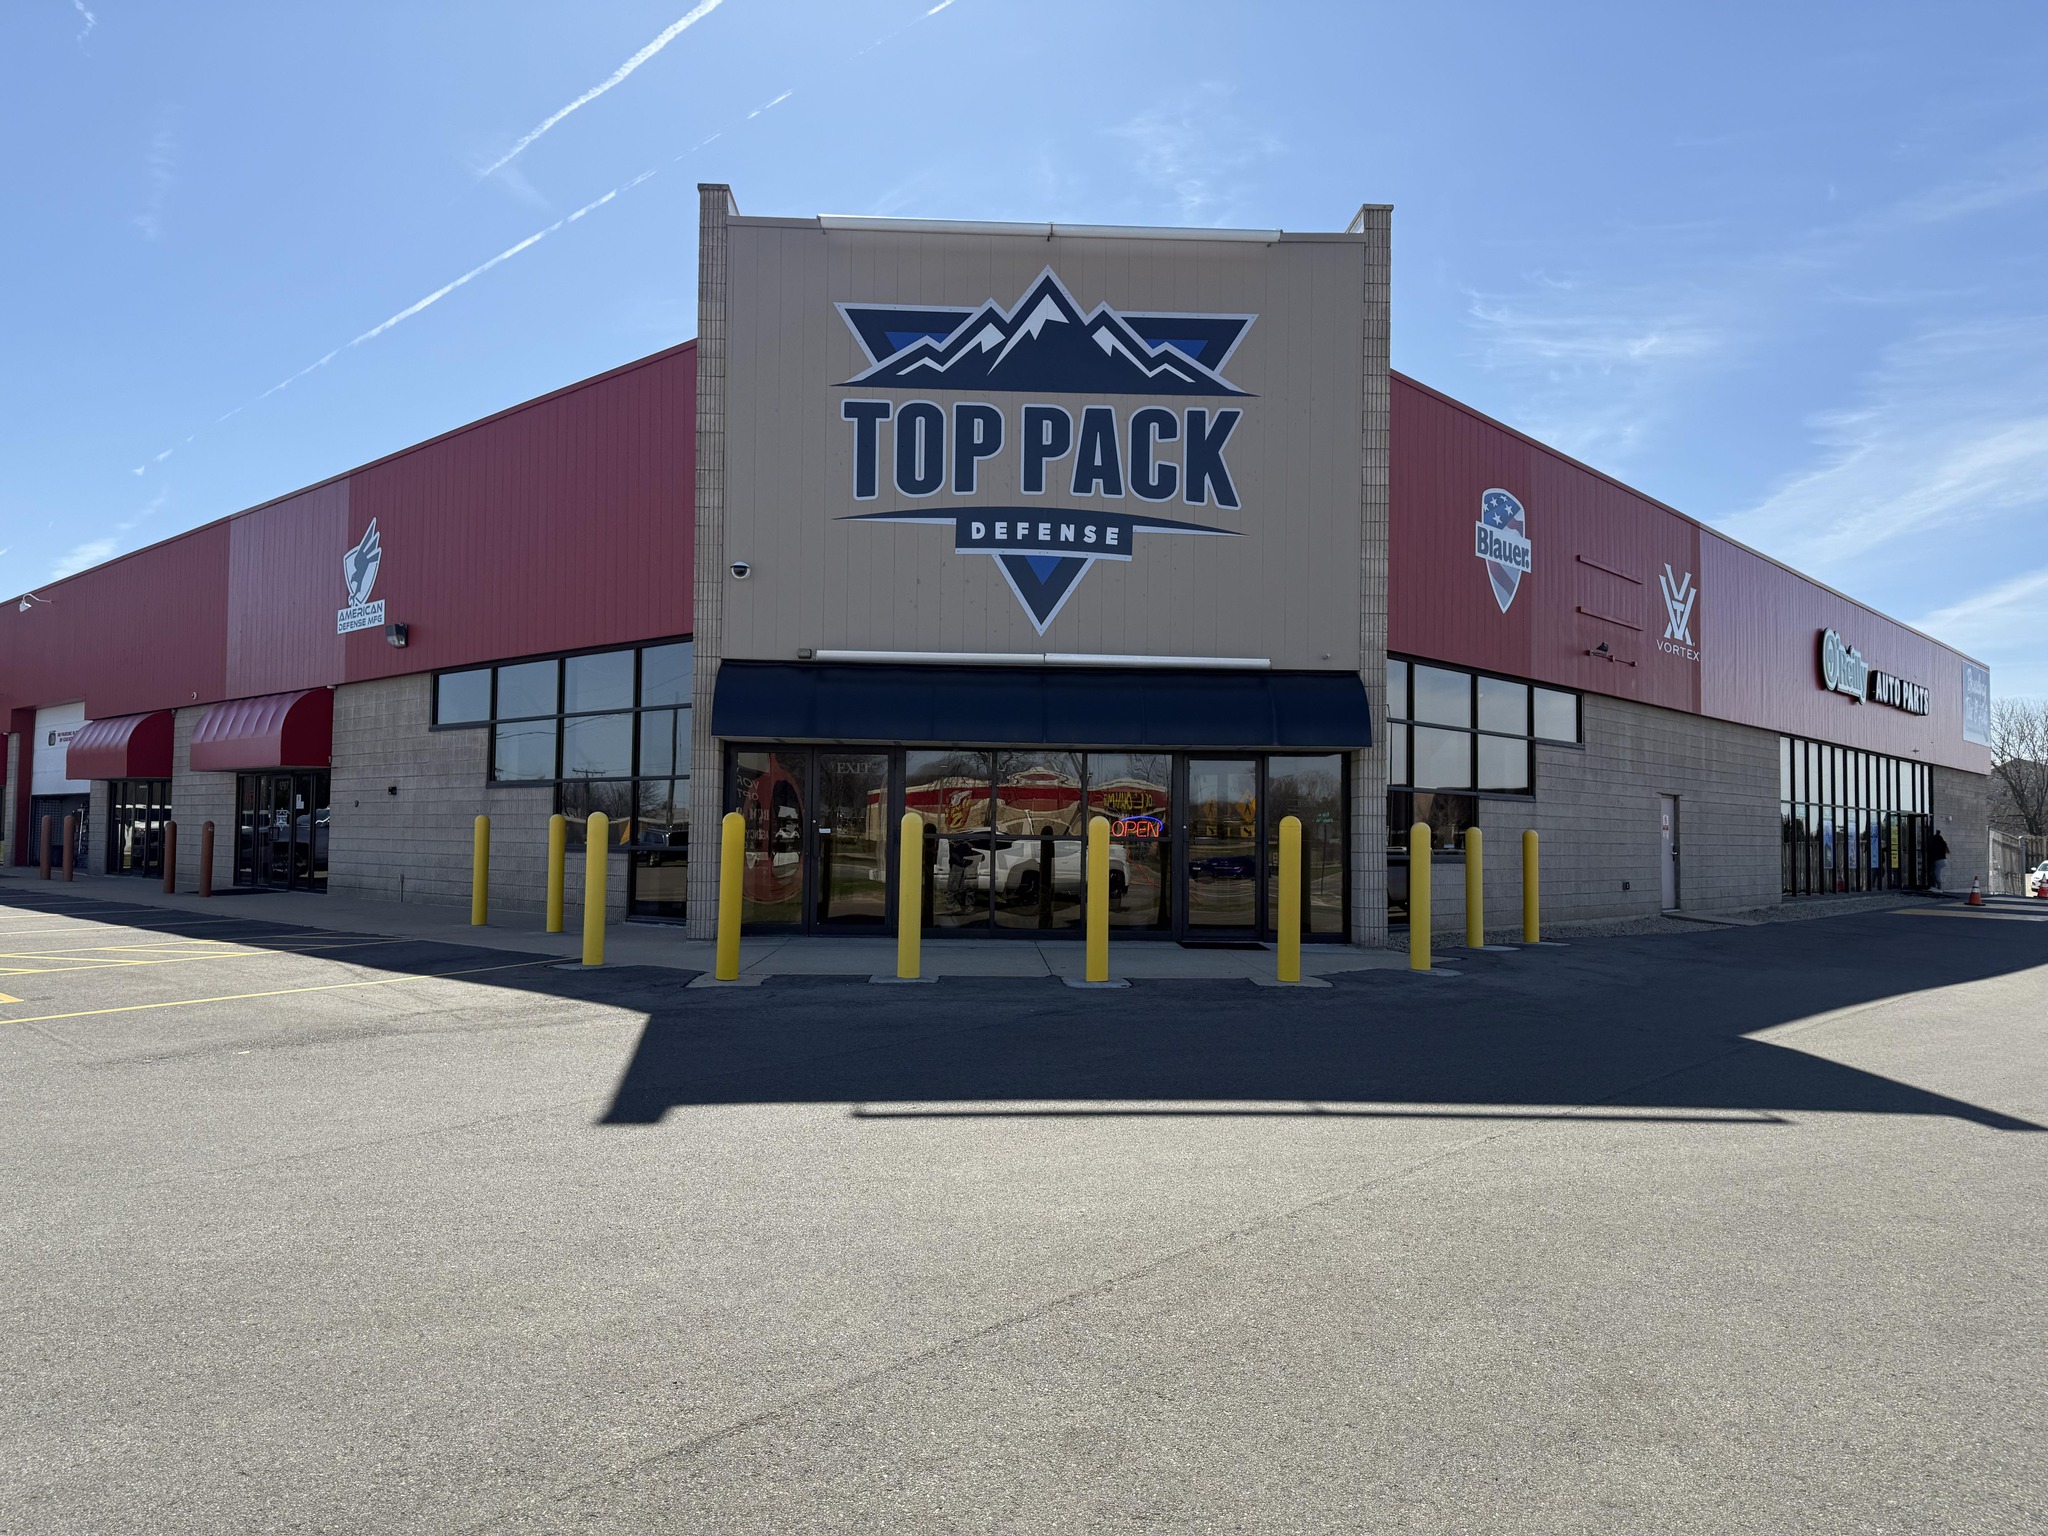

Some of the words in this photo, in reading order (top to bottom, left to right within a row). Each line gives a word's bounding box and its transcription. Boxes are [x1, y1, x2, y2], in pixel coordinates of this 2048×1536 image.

[841, 399, 1005, 500] TOP
[1021, 404, 1243, 510] PACK
[971, 521, 1119, 546] DEFENSE
[338, 602, 383, 622] AMERICAN
[338, 618, 367, 631] DEFENSE
[367, 614, 383, 626] MFG
[1656, 639, 1700, 662] VORTEX
[1875, 671, 1901, 708] AUTO
[1902, 681, 1930, 717] PARTS
[836, 761, 872, 774] EXIT
[1111, 820, 1161, 838] OPEN
